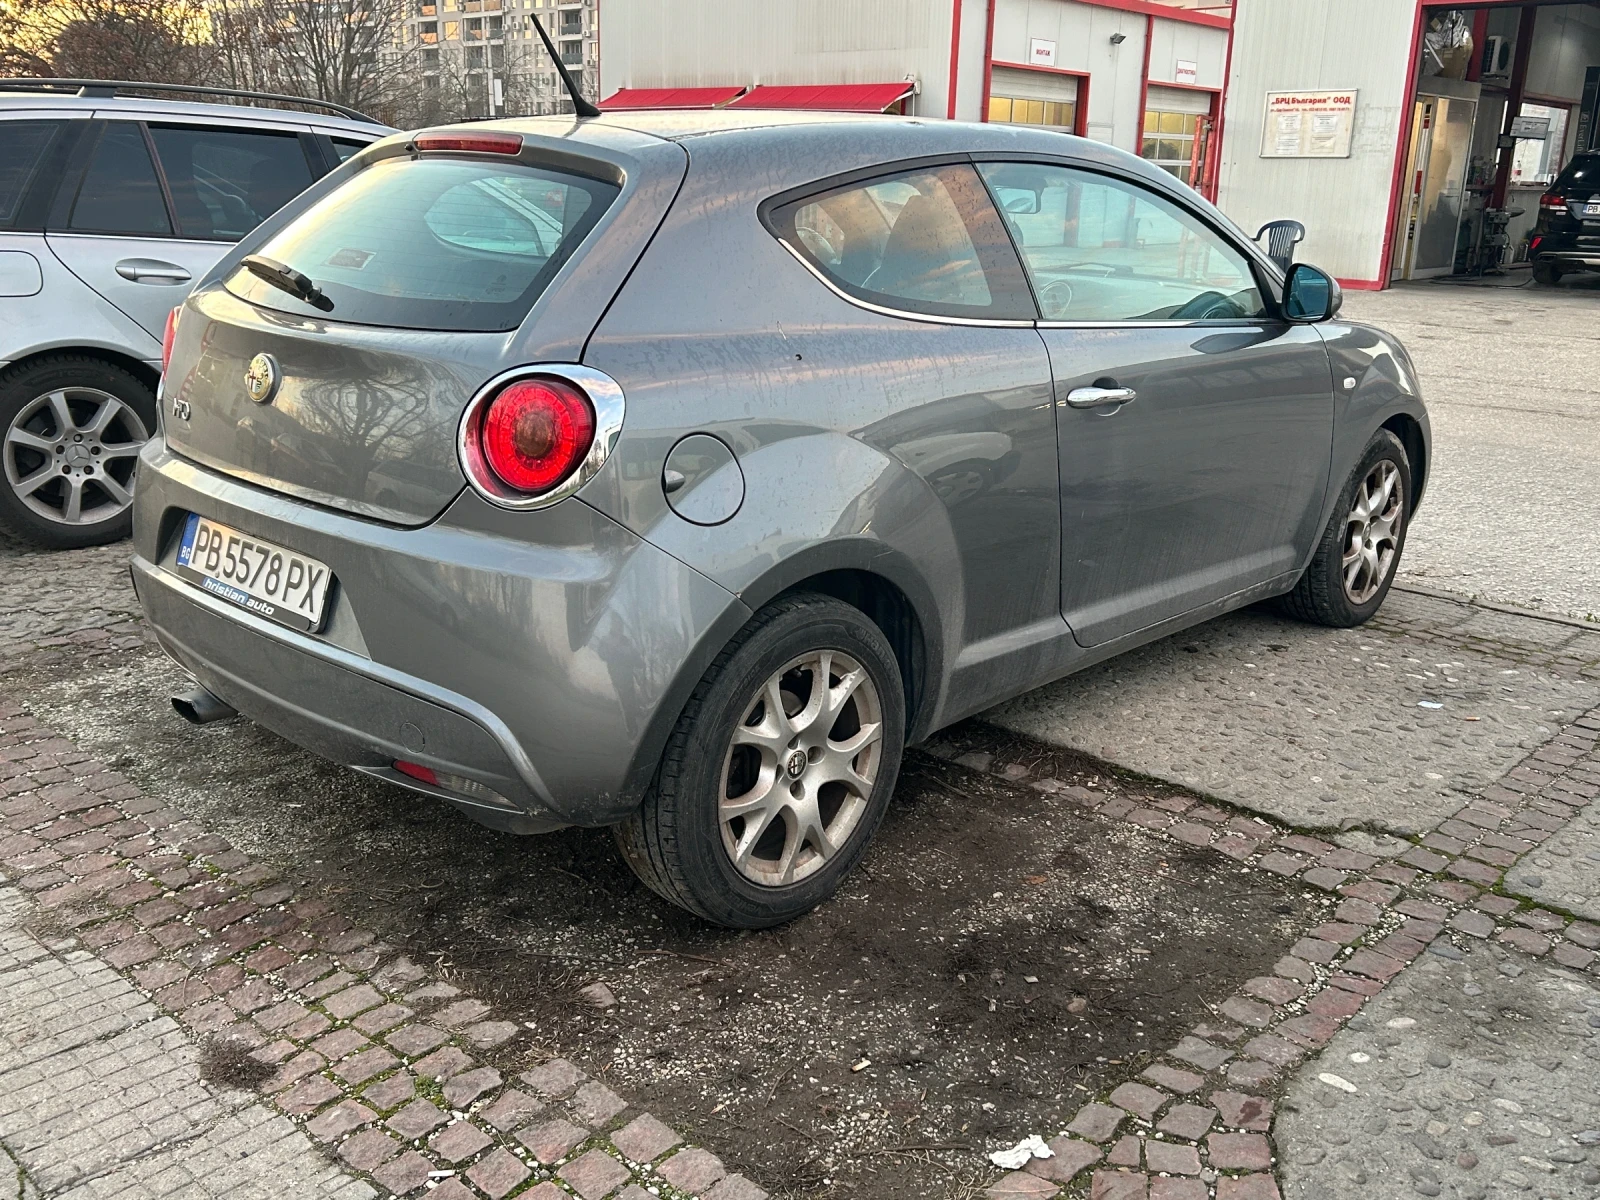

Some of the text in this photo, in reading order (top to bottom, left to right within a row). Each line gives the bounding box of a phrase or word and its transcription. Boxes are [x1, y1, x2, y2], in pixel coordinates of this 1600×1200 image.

[1333, 96, 1351, 105] ООД
[181, 546, 190, 560] BG
[204, 578, 275, 615] hristian auto
